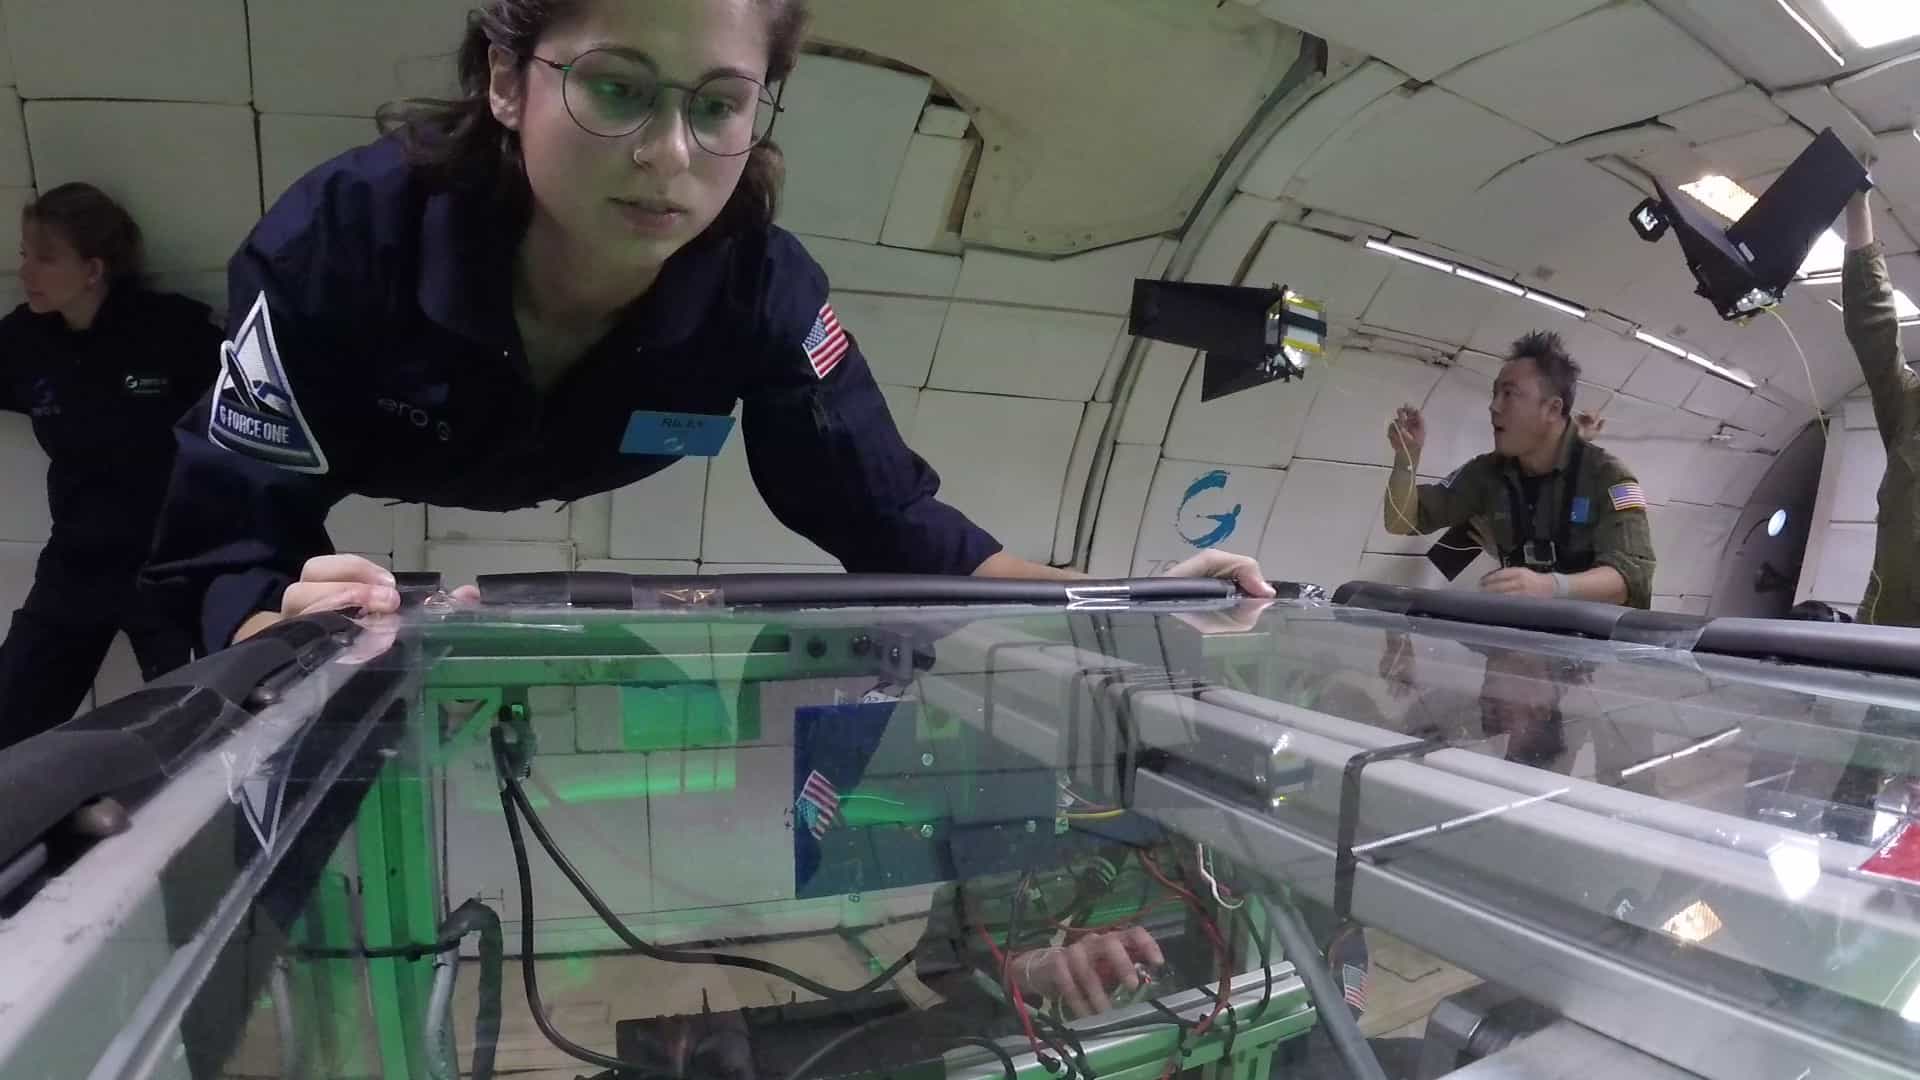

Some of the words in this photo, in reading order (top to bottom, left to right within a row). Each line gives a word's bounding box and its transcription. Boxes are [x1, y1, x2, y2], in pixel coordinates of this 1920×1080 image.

[219, 404, 228, 425] G
[227, 408, 262, 439] FORCE
[263, 422, 289, 444] ONE
